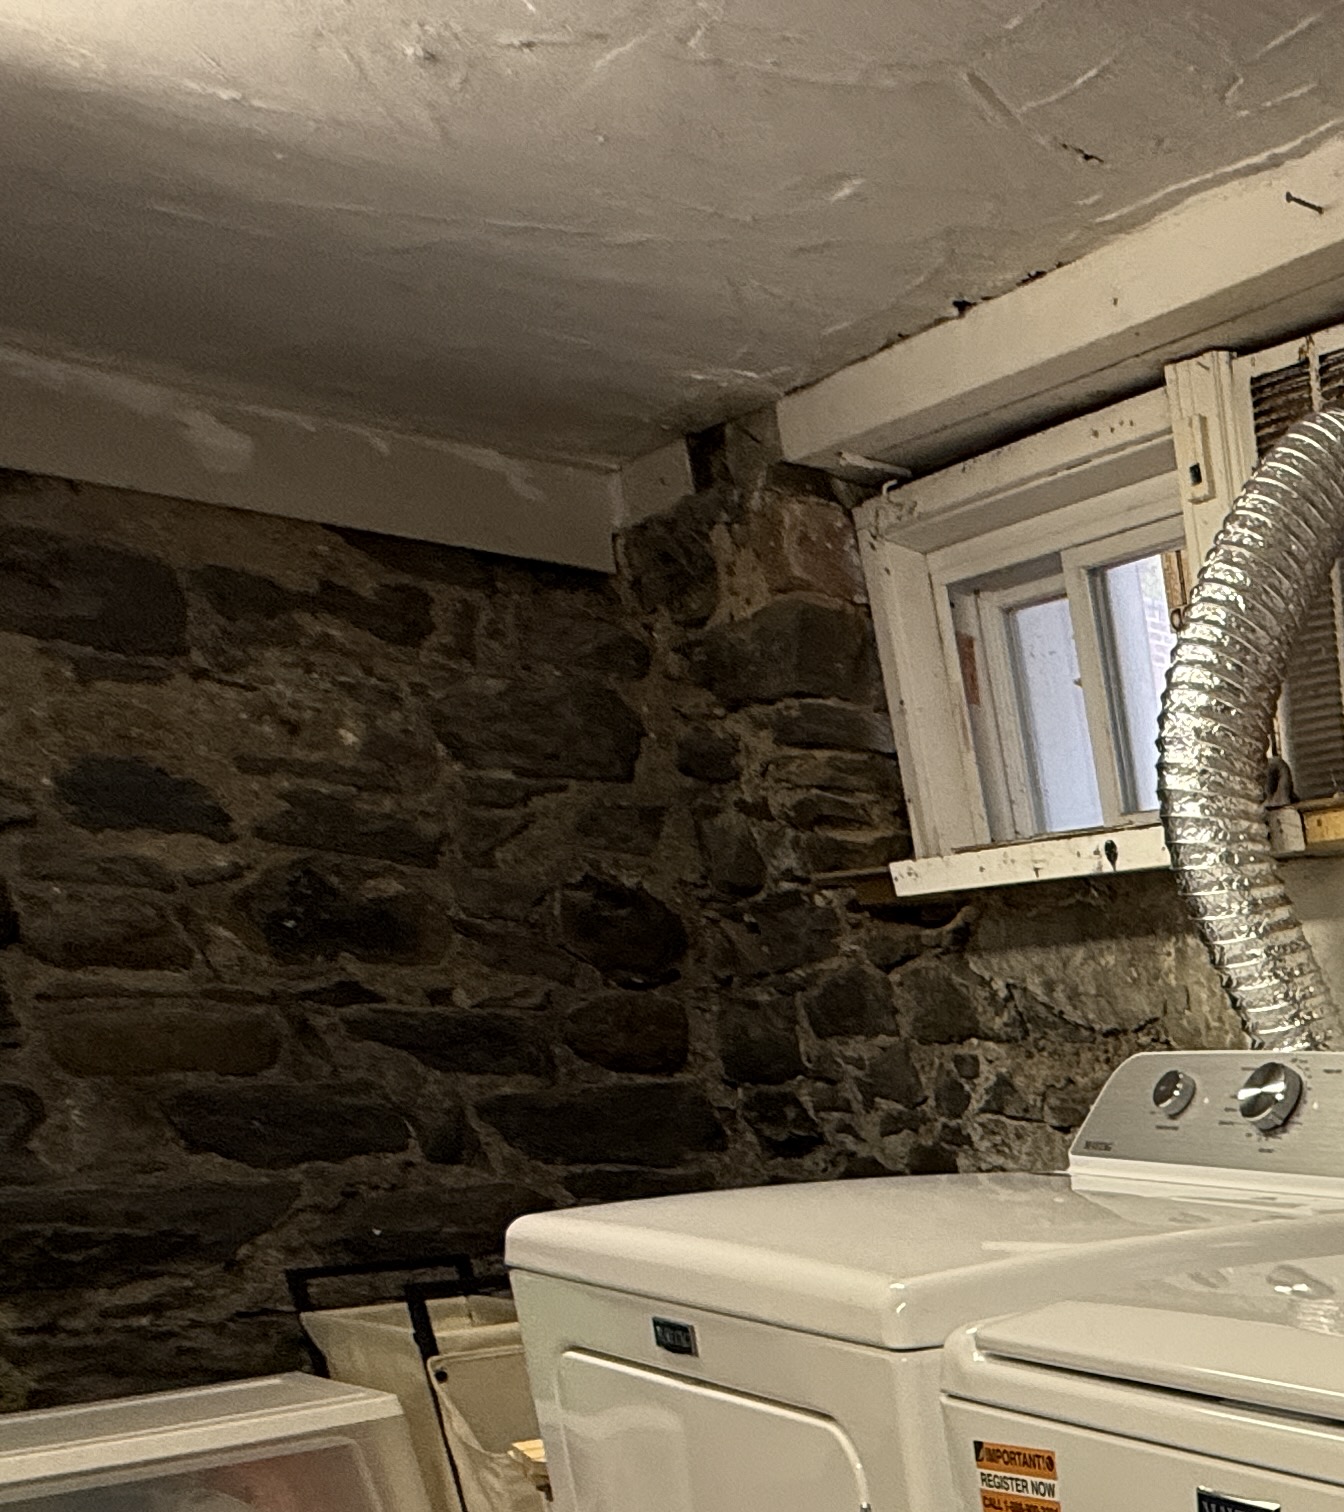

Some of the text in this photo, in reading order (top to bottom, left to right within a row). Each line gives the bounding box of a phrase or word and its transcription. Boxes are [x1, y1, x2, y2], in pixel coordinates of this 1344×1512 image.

[980, 1472, 1056, 1498] REGISTER NOW
[982, 1496, 1003, 1511] CALL
